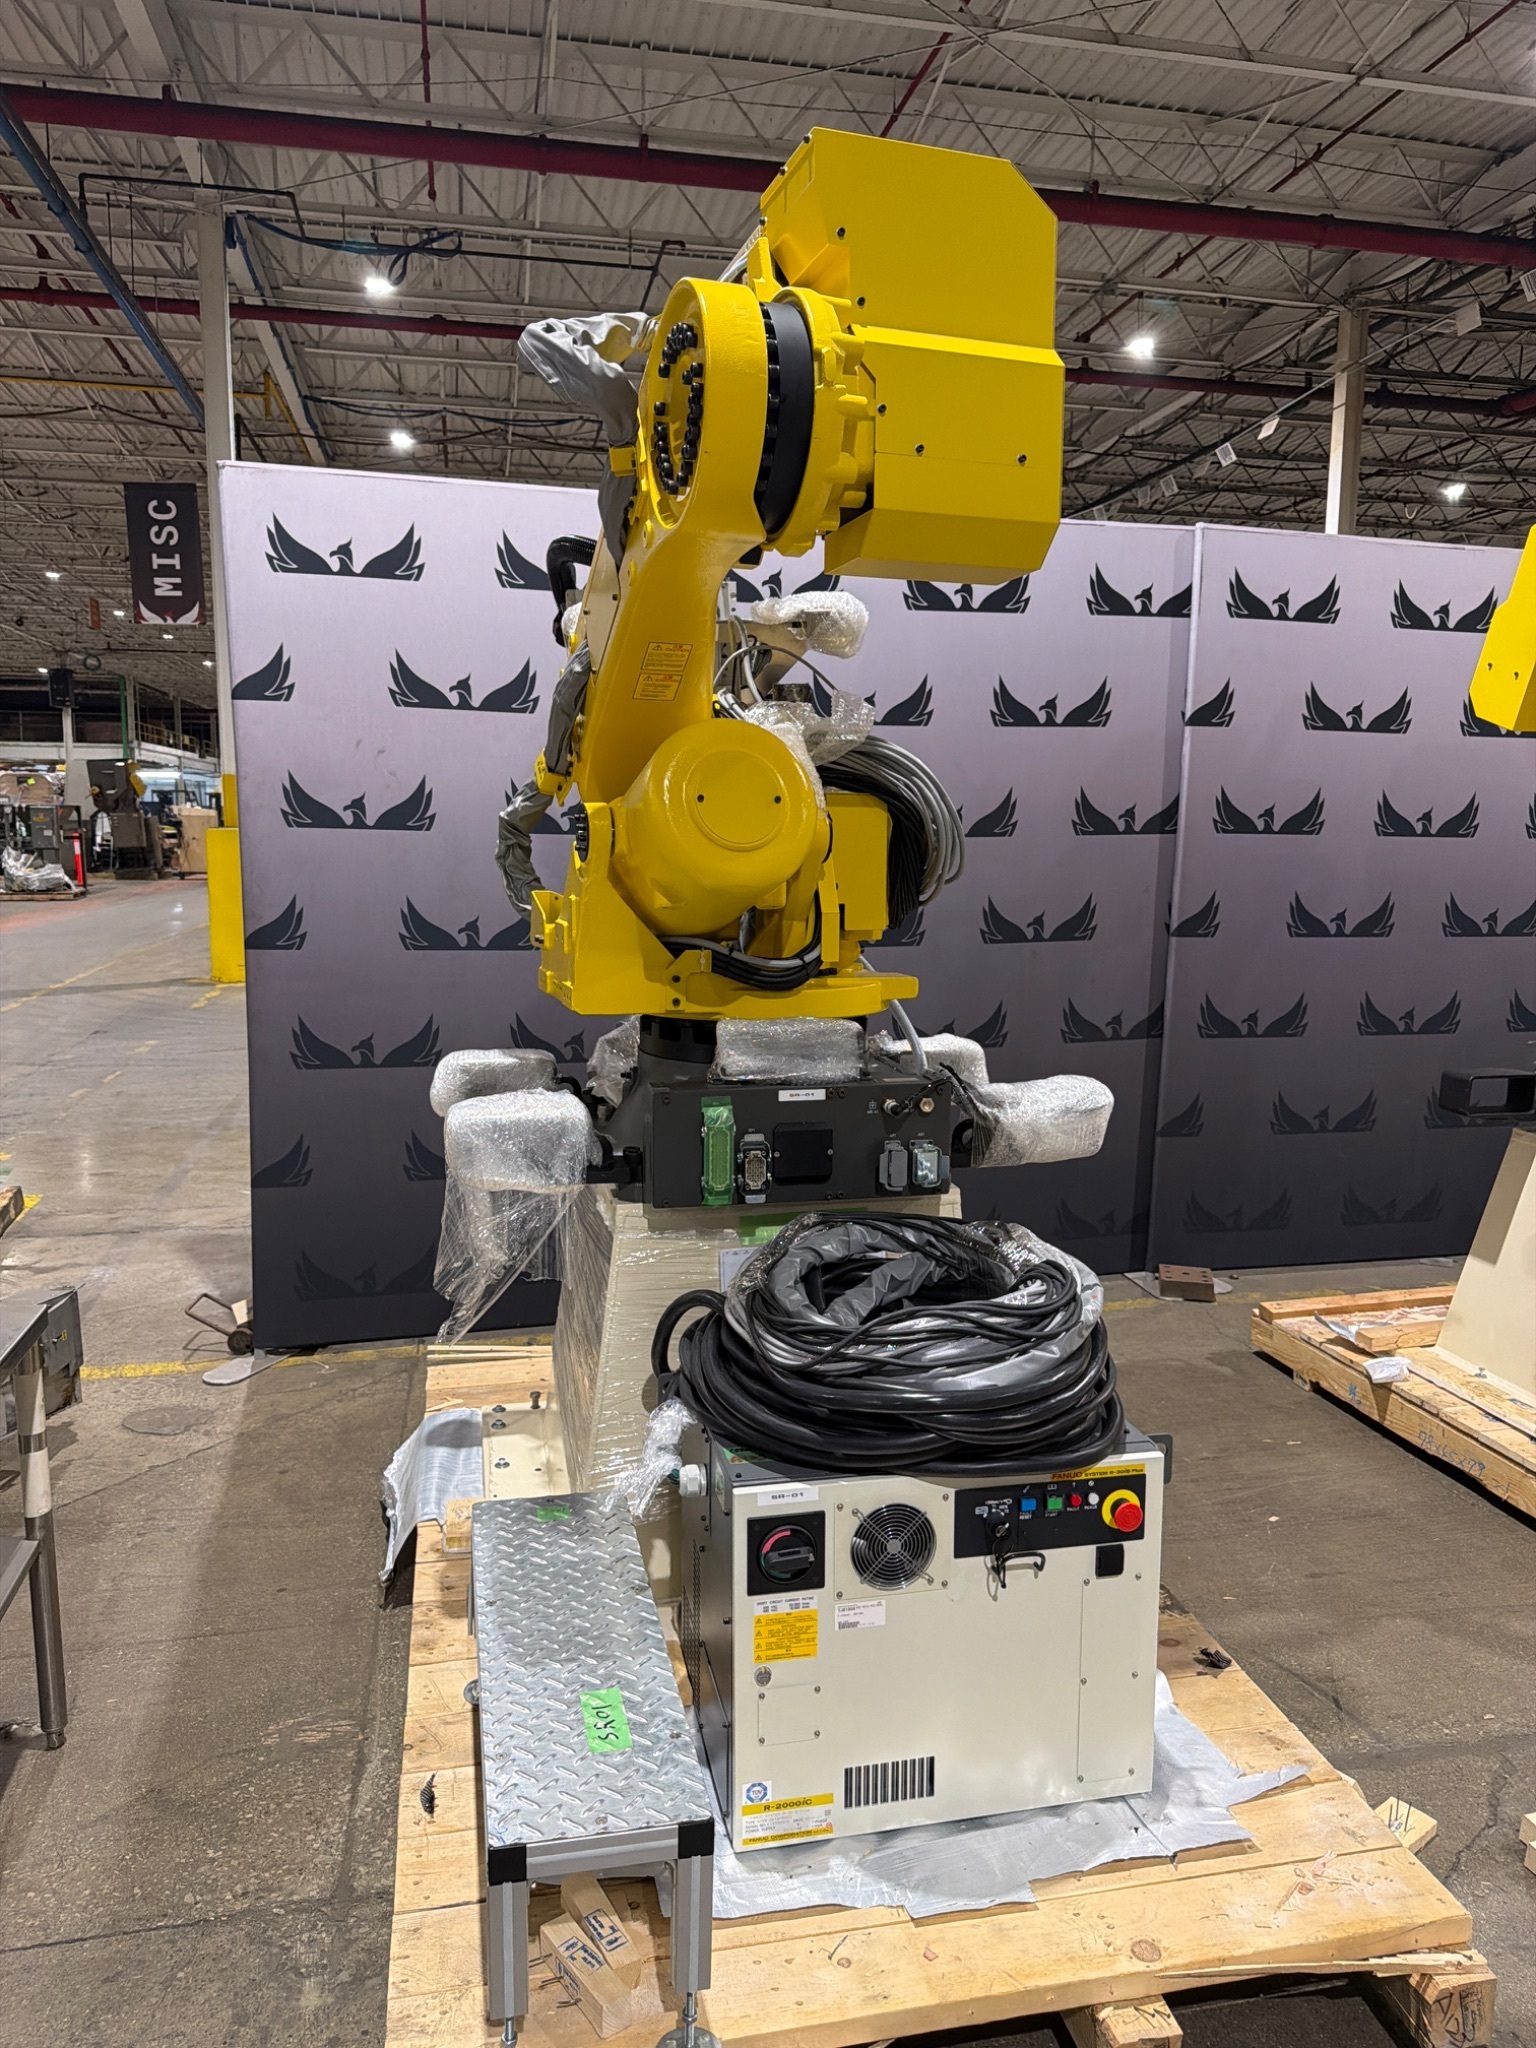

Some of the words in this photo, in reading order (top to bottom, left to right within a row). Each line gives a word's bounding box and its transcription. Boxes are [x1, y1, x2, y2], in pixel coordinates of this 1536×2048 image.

[147, 499, 183, 597] MISC
[1051, 1471, 1083, 1480] FANUC
[763, 1797, 813, 1812] R-2000iC
